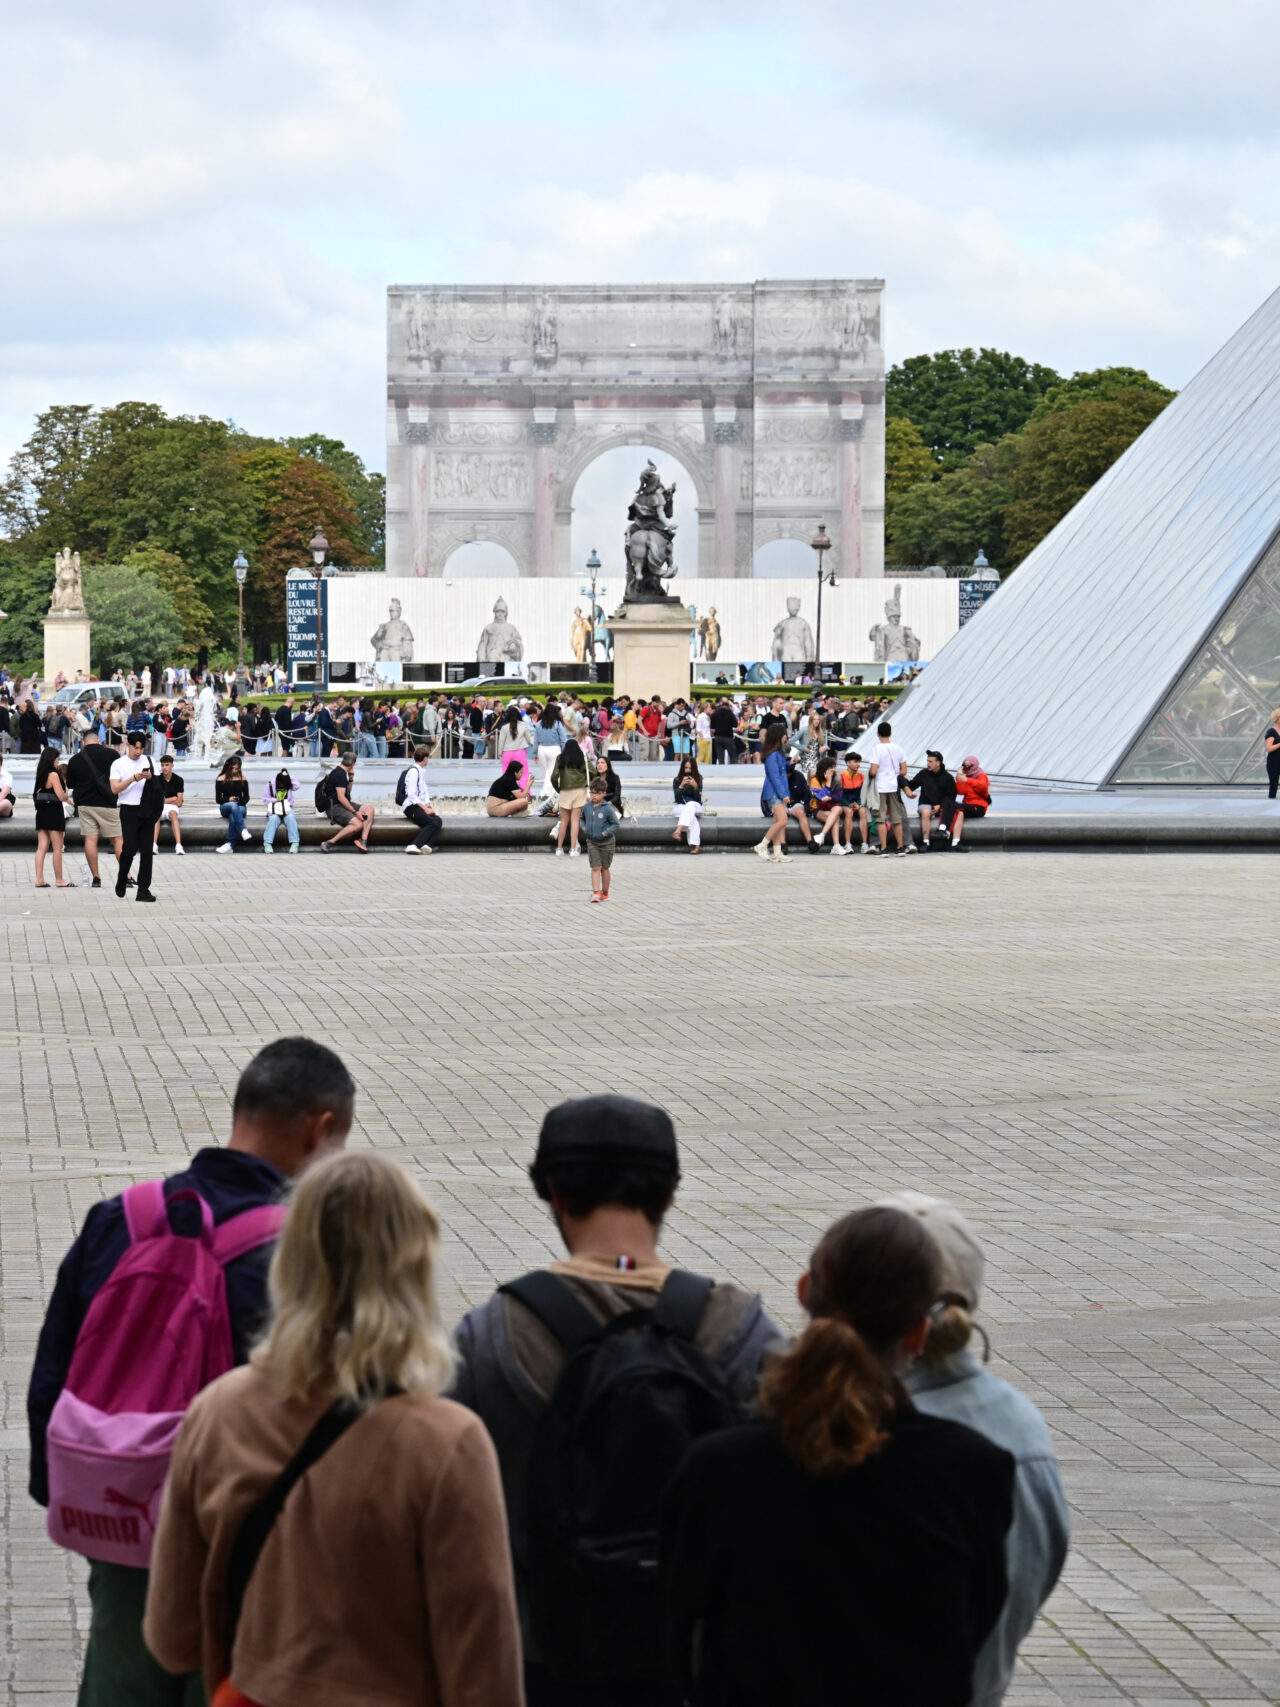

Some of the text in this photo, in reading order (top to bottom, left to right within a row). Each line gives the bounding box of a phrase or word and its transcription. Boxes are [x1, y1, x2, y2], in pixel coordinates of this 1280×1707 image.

[298, 581, 322, 590] MUSÉ
[288, 591, 299, 599] DU
[288, 599, 316, 607] LOUVRE
[288, 616, 307, 624] L'ARC
[288, 641, 299, 649] DU
[60, 1505, 141, 1545] PUMA
